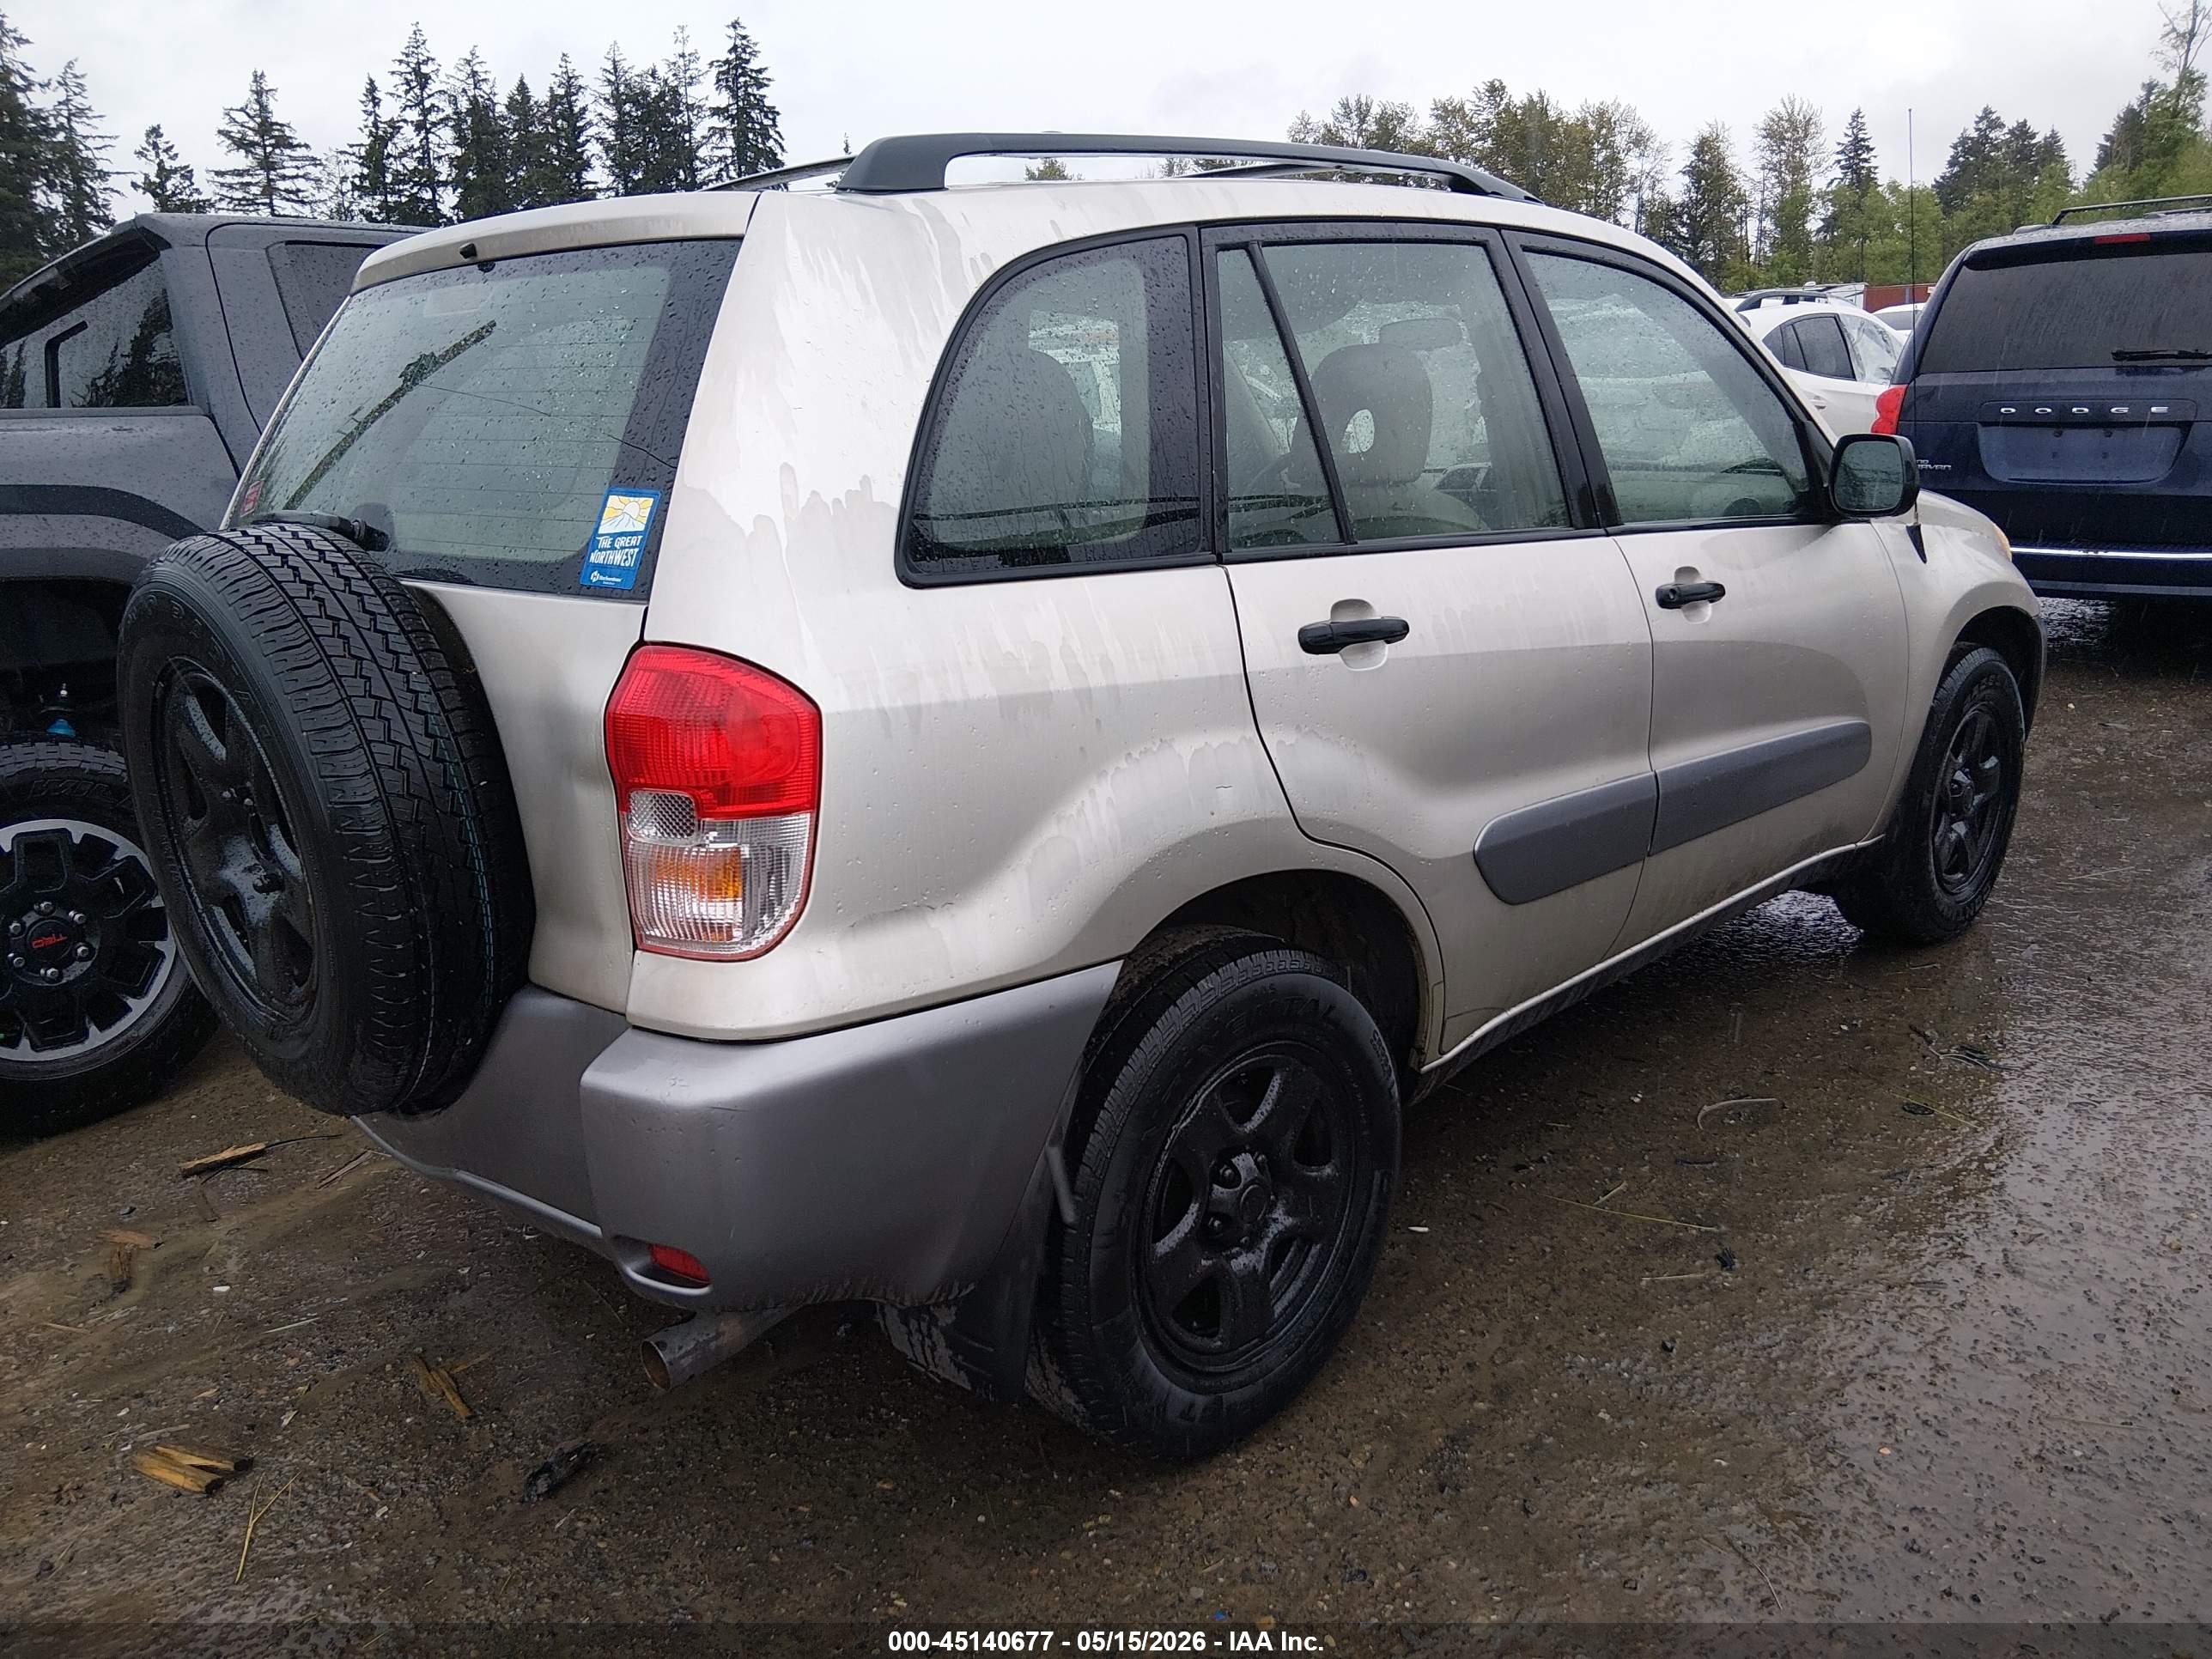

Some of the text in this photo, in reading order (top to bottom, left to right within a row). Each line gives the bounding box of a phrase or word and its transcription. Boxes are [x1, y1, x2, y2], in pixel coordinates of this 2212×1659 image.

[596, 535, 643, 549] THE GREAT
[589, 548, 640, 567] NORTHWEST
